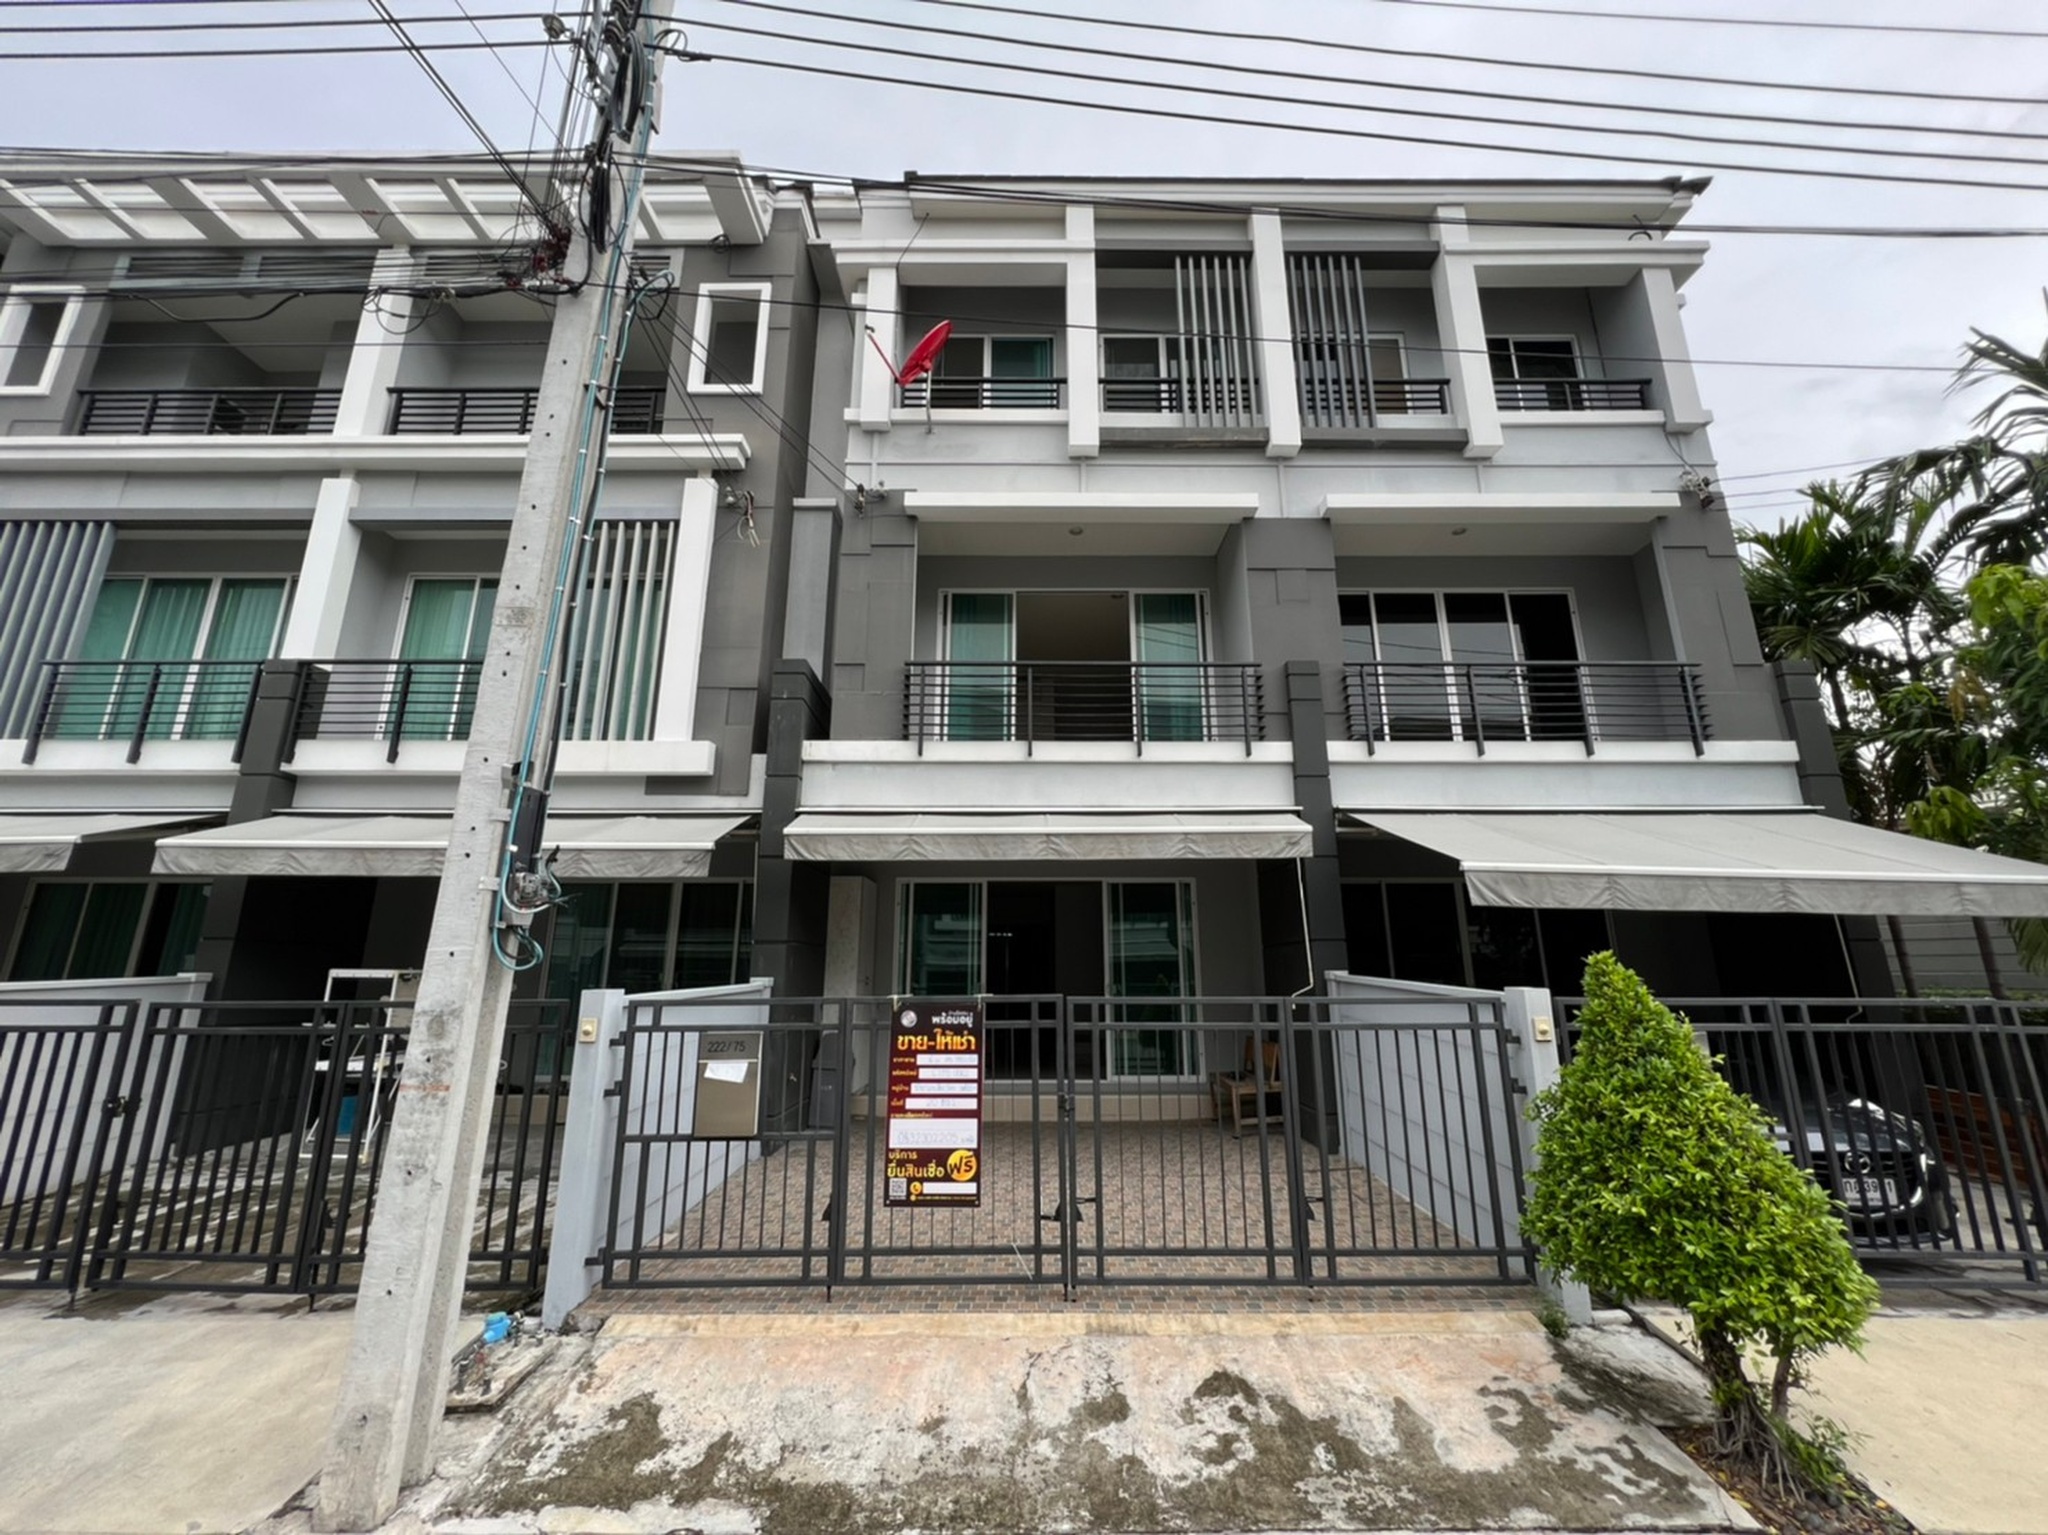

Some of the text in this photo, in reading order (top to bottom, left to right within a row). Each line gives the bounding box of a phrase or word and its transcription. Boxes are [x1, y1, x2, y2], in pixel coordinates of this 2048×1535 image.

[931, 1011, 973, 1028] พร้อมอยู่
[897, 1028, 976, 1050] ขาย-ให้เช่า
[888, 1149, 918, 1159] บริการ
[948, 1150, 975, 1176] ฟรี
[887, 1159, 945, 1178] ยื่นสินเชื่อ
